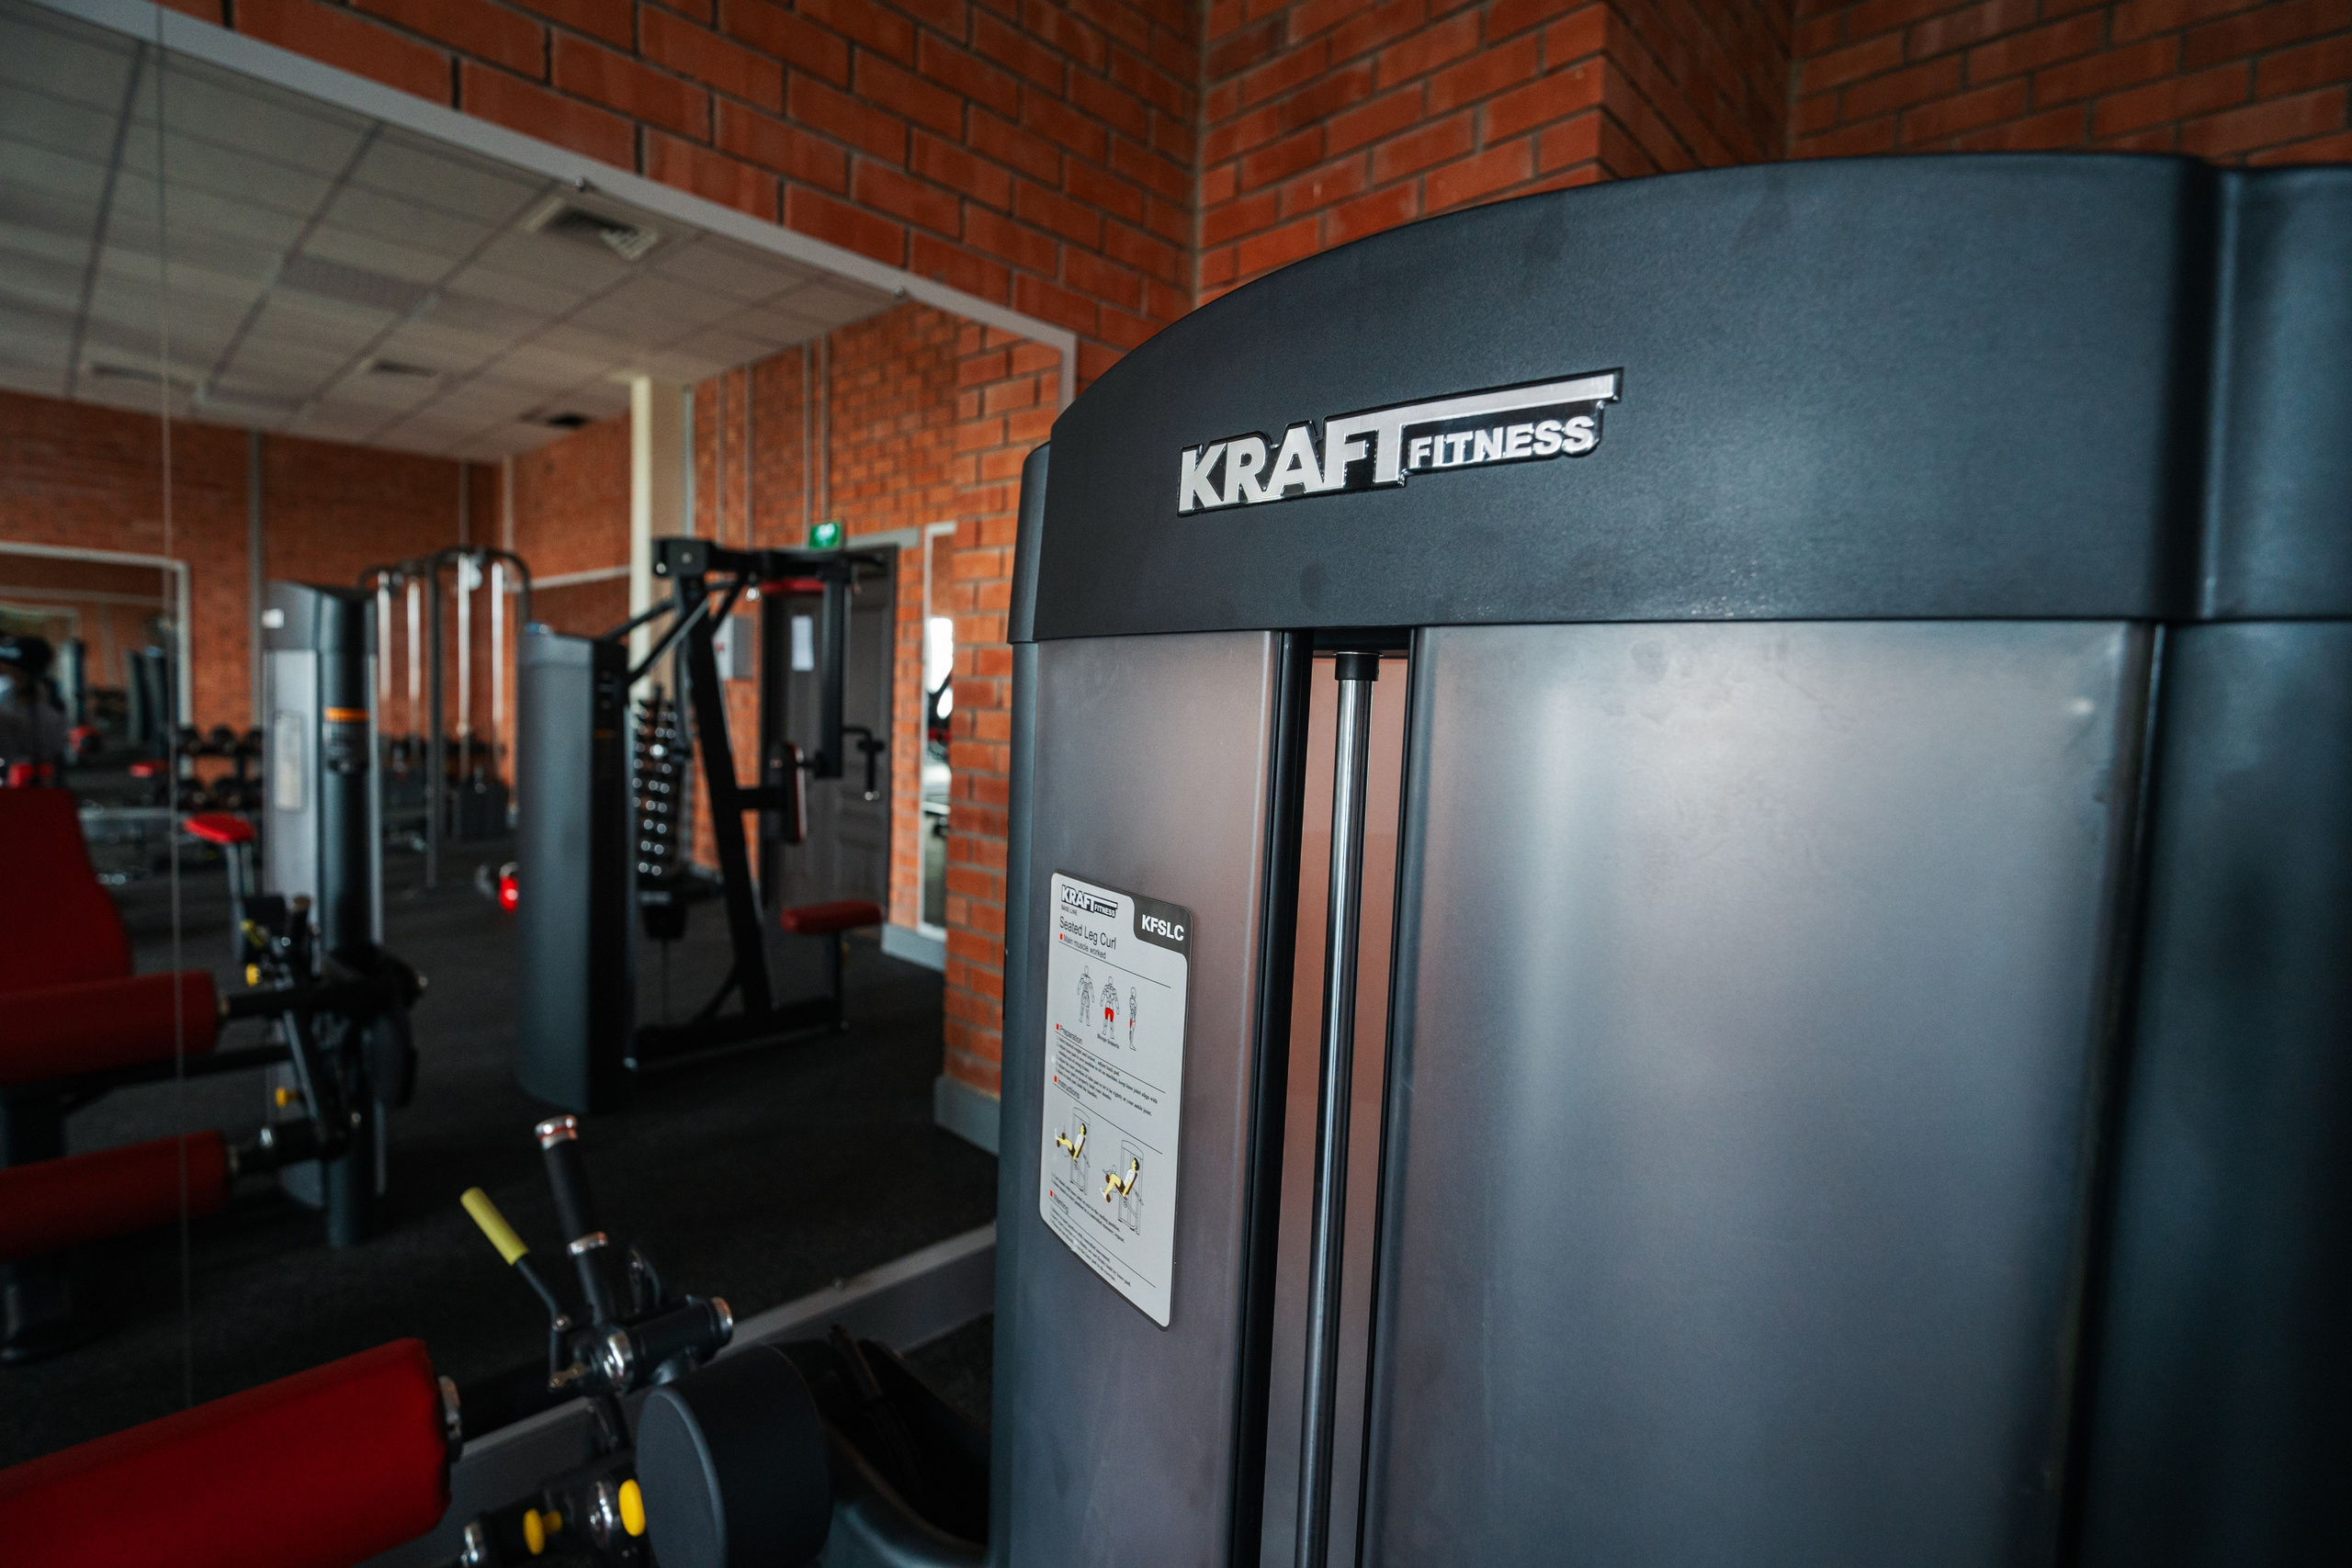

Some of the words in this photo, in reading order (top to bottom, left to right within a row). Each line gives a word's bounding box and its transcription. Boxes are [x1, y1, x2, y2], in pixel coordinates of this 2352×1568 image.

[1179, 371, 1616, 513] KRAFT
[1408, 414, 1596, 469] FITNESS
[1061, 884, 1118, 914] KRAFT
[1094, 903, 1115, 919] FITNESS
[1059, 916, 1082, 936] Seated
[1084, 926, 1098, 945] Leg
[1100, 932, 1116, 950] Curl
[1141, 914, 1184, 942] KFSLC
[1074, 940, 1089, 952] muscle
[1090, 947, 1106, 959] worked
